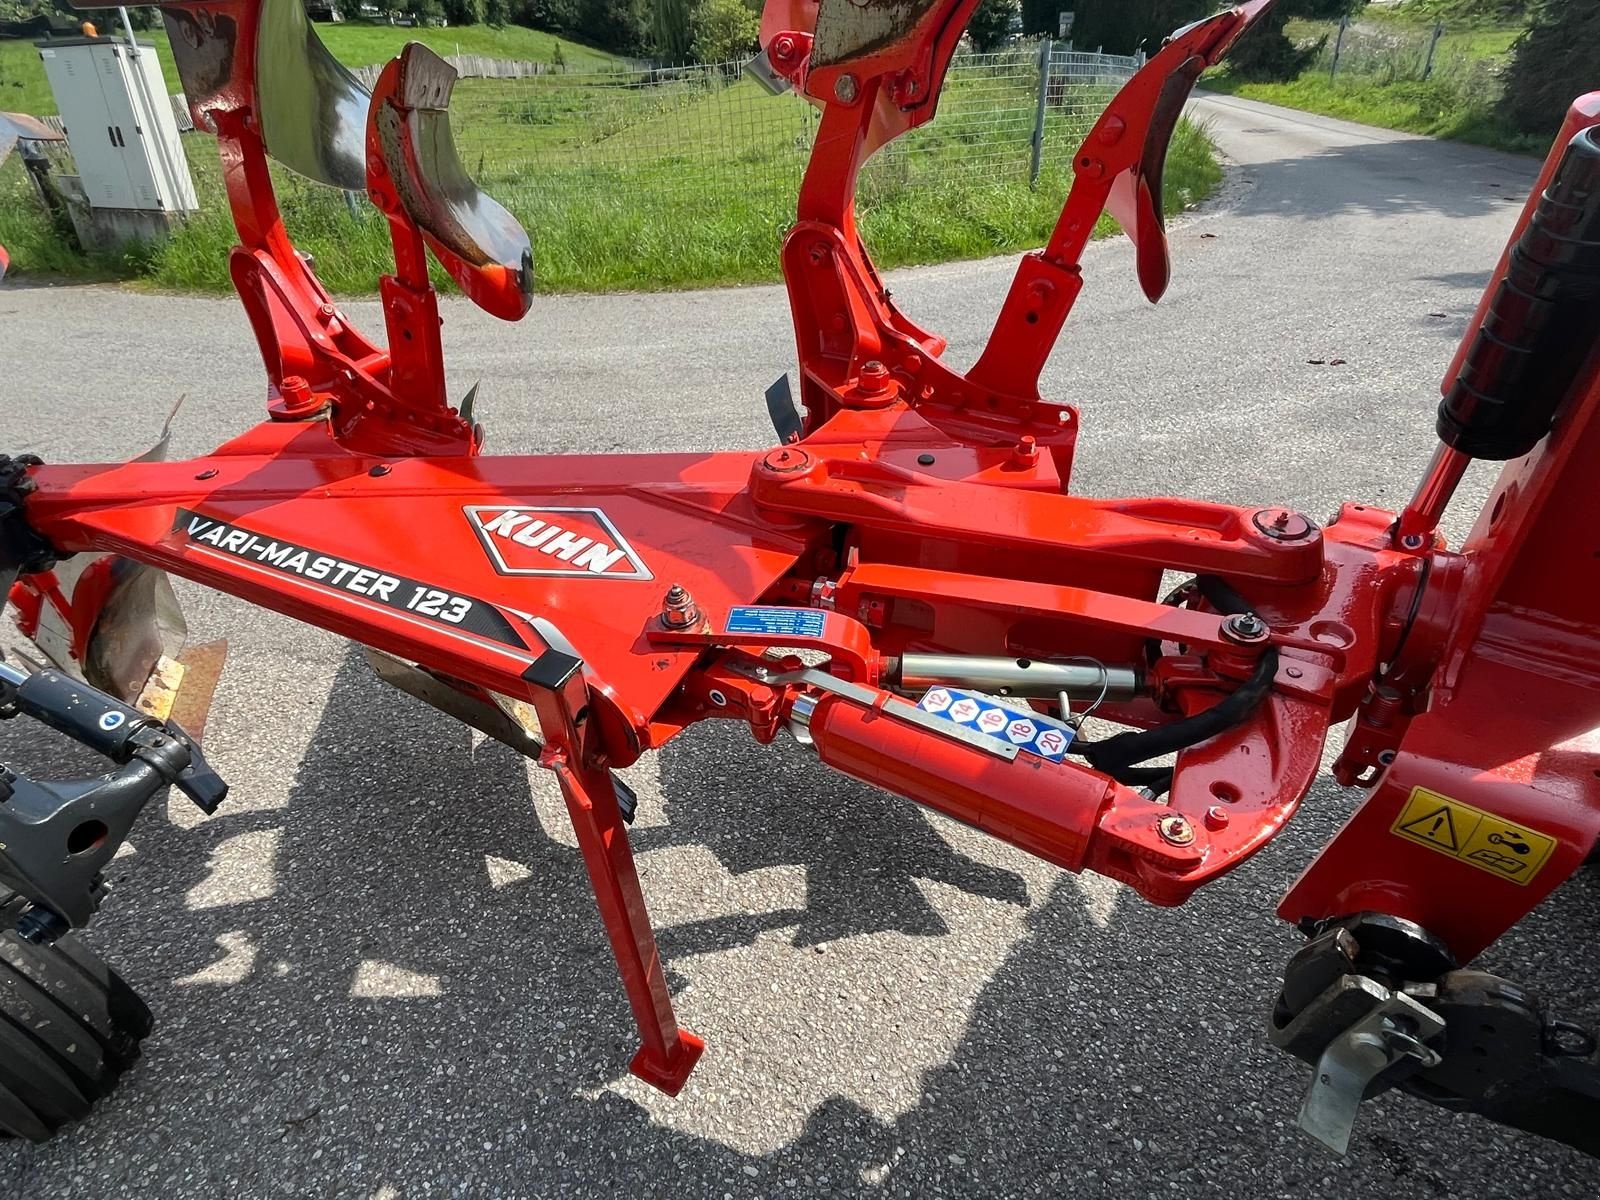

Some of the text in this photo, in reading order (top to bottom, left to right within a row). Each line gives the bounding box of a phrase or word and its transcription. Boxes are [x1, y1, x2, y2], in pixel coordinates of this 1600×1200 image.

[187, 516, 473, 624] VARI-MASTER 123
[481, 509, 627, 574] KUHN
[927, 693, 1063, 753] 12 14 16 18 20
